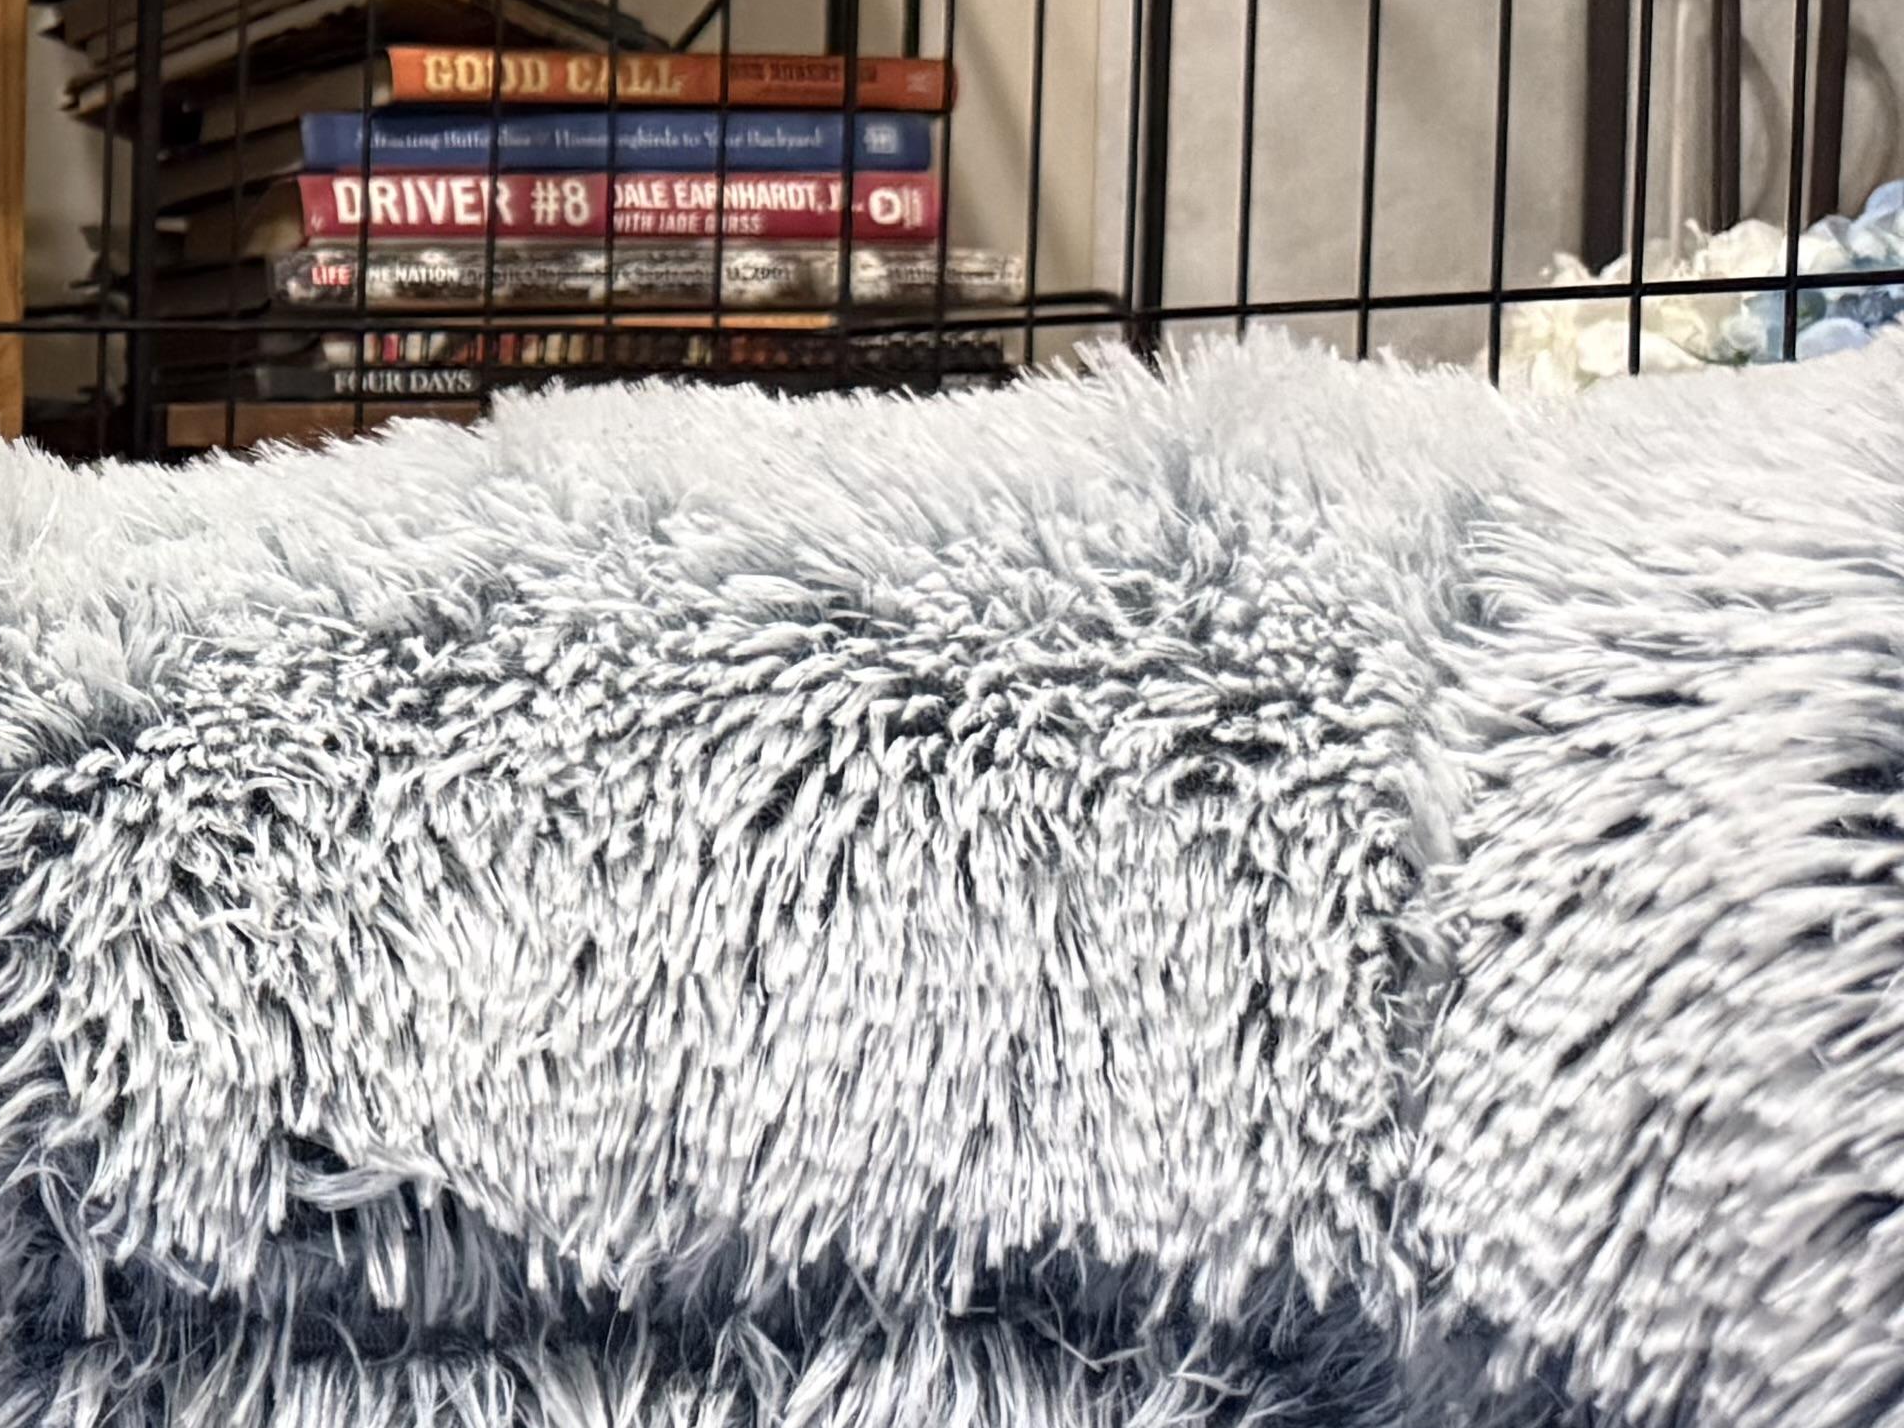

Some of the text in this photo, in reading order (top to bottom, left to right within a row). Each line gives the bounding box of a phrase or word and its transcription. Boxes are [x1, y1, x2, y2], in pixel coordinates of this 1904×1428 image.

[331, 177, 589, 225] DRIVER #8
[312, 265, 352, 286] LIFE
[395, 266, 460, 285] NATION
[409, 371, 474, 393] DAYS
